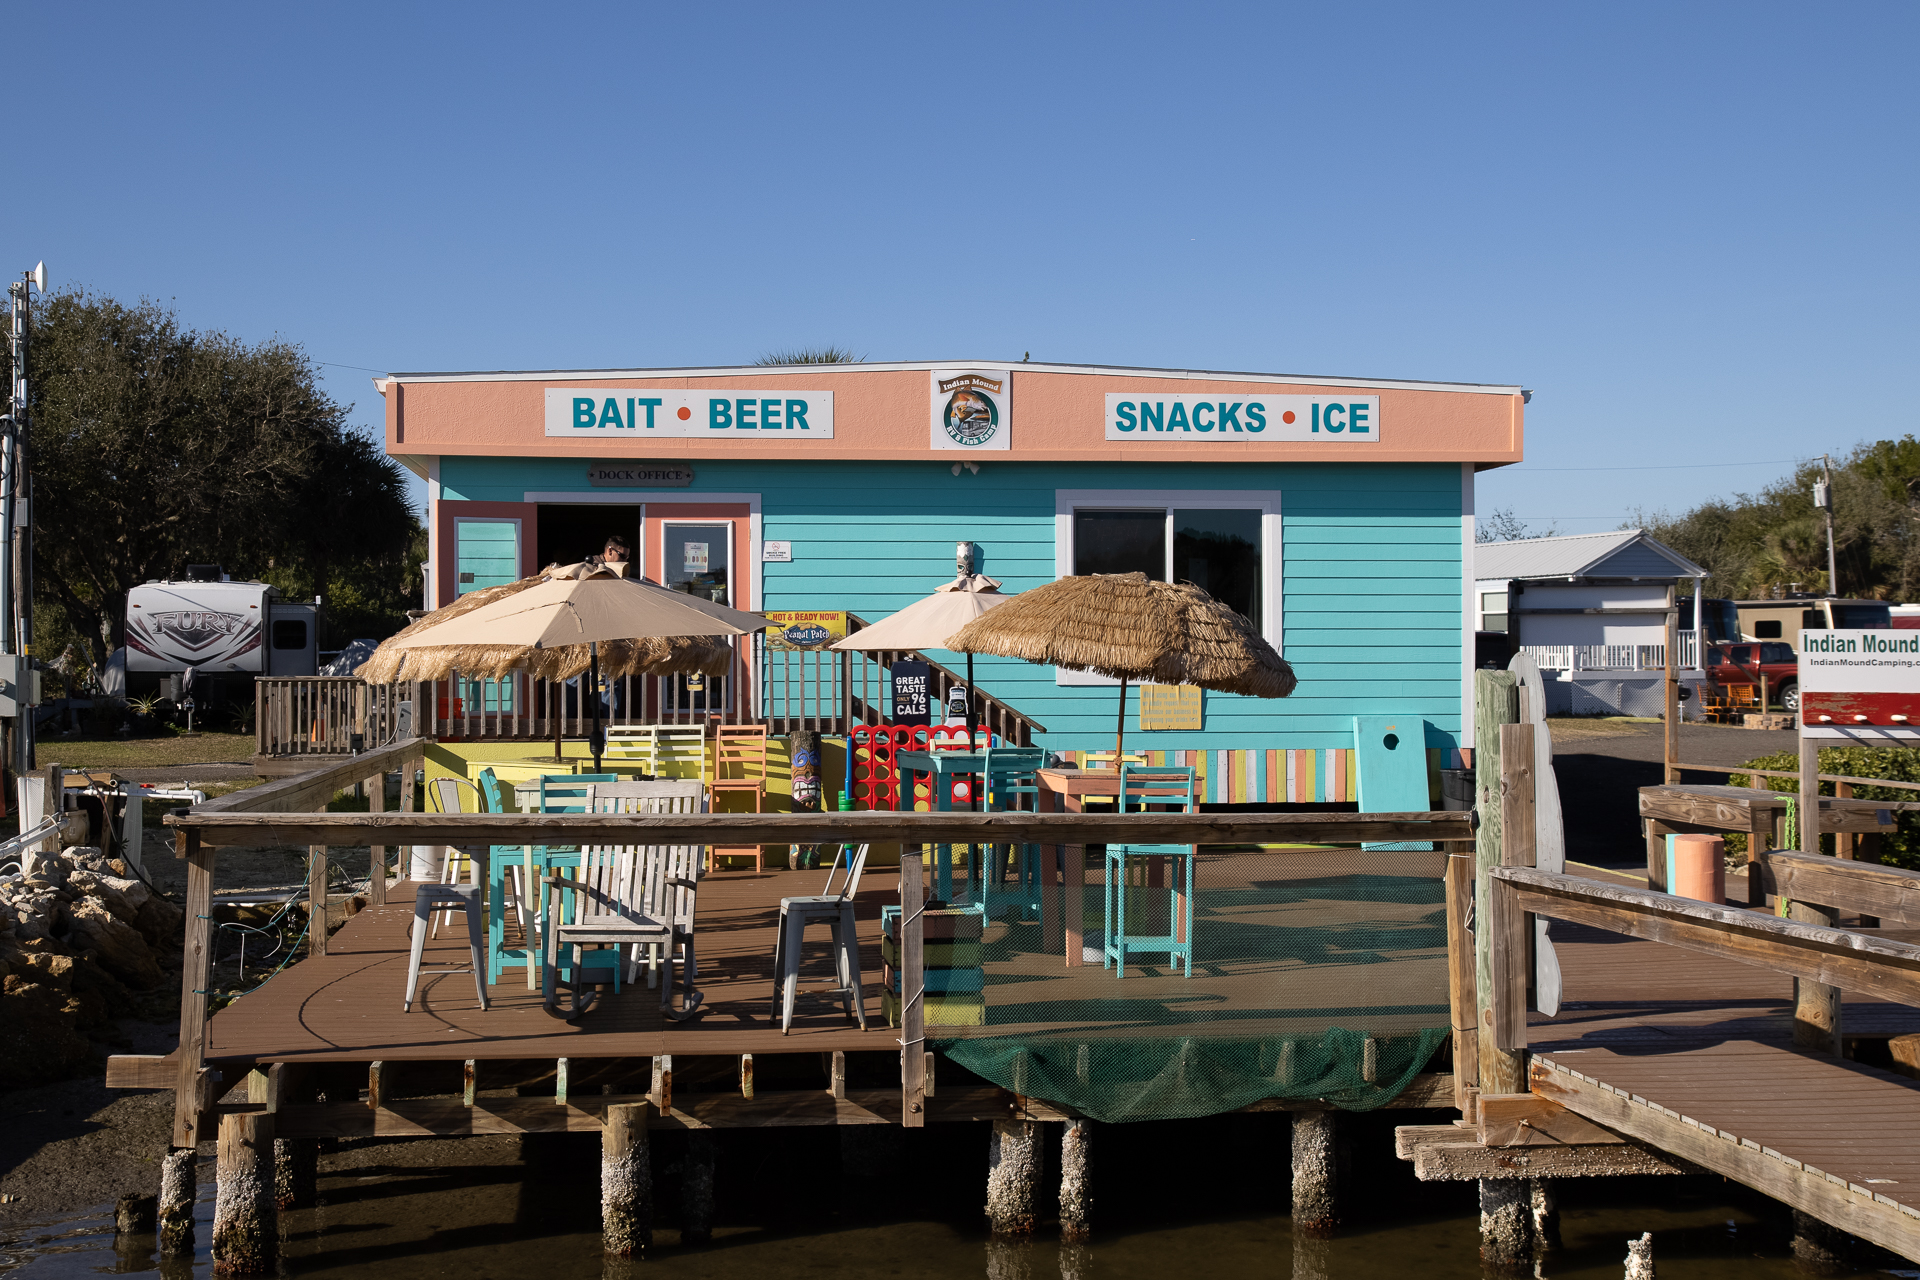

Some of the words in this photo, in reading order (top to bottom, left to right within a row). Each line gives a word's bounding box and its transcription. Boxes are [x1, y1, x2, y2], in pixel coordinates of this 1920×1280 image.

[942, 379, 970, 390] Indian
[972, 378, 999, 390] Mound
[572, 397, 662, 428] BAIT
[708, 398, 810, 430] BEER
[1115, 401, 1266, 432] SNACKS
[1311, 402, 1370, 433] ICE
[946, 426, 956, 436] RV
[980, 424, 997, 442] Camp
[598, 470, 634, 480] DOCK
[638, 470, 682, 480] OFFICE
[772, 613, 786, 621] HOT
[787, 613, 793, 621] &
[794, 612, 818, 621] READY
[152, 612, 240, 635] FURY
[784, 630, 808, 640] Peanut
[811, 629, 830, 639] Patch
[1804, 634, 1856, 652] Indian
[1862, 634, 1919, 653] Mound
[896, 676, 926, 685] GREAT
[896, 685, 926, 693] TASTE
[911, 693, 926, 704] 96
[897, 704, 926, 715] CALS
